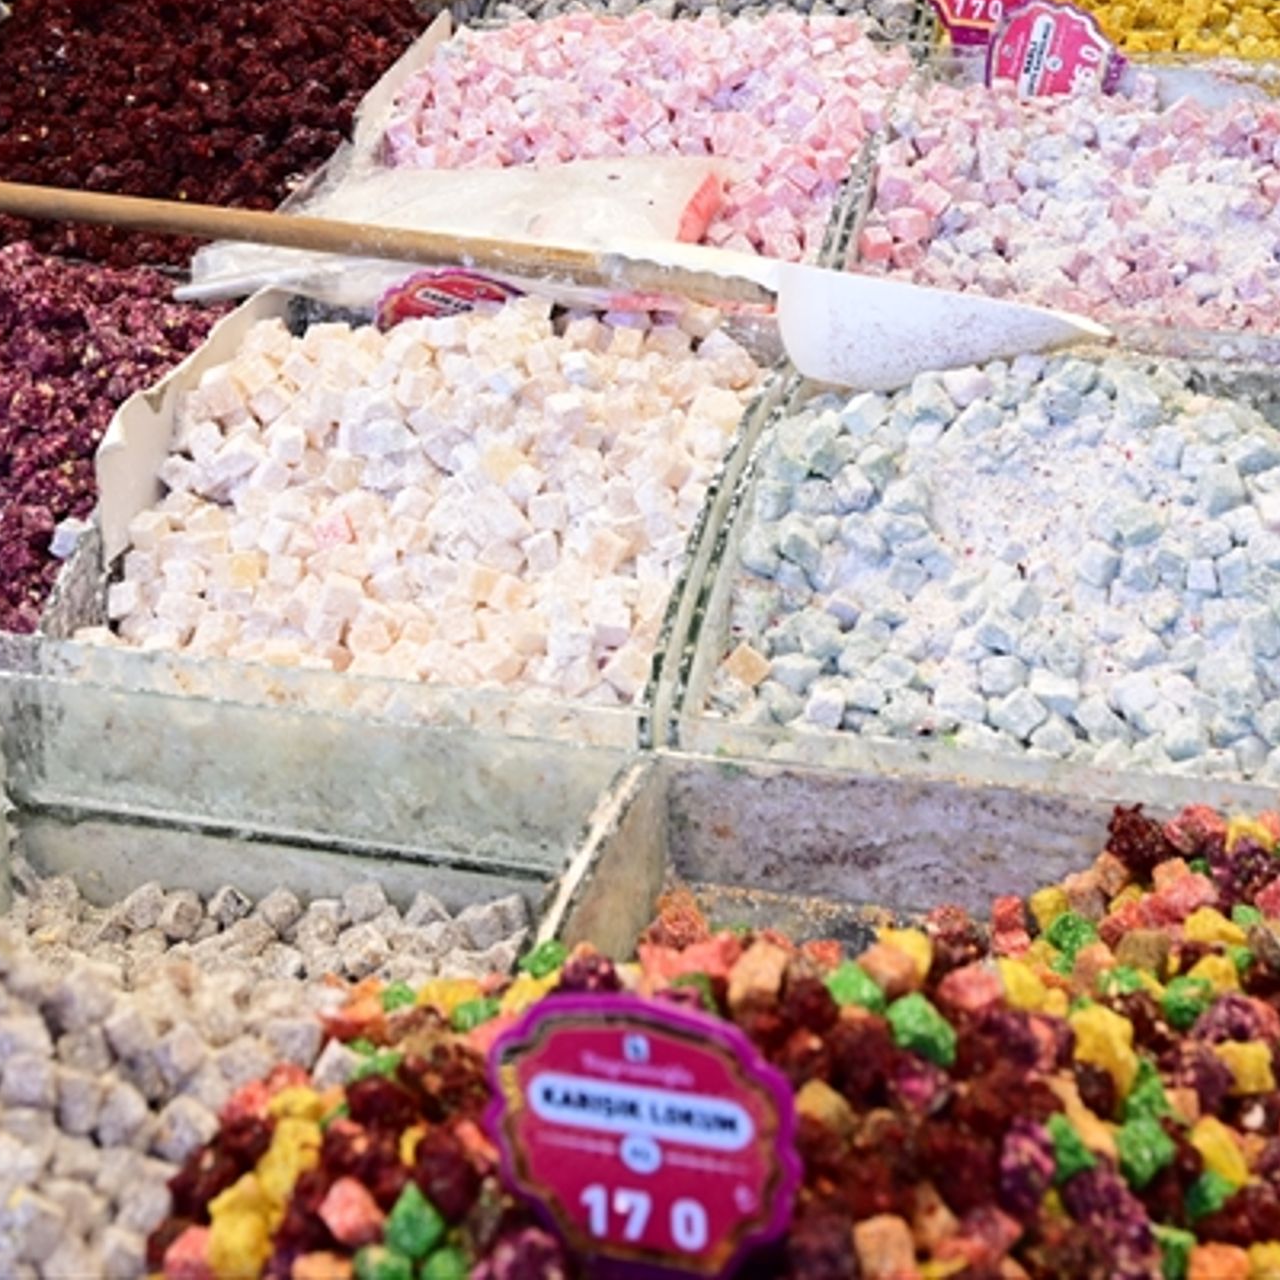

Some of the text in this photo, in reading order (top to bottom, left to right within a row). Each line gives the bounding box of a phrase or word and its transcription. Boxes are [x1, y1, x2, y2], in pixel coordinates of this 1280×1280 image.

[541, 1085, 739, 1132] KARIŞIK LOKUM
[578, 1183, 709, 1252] 170
